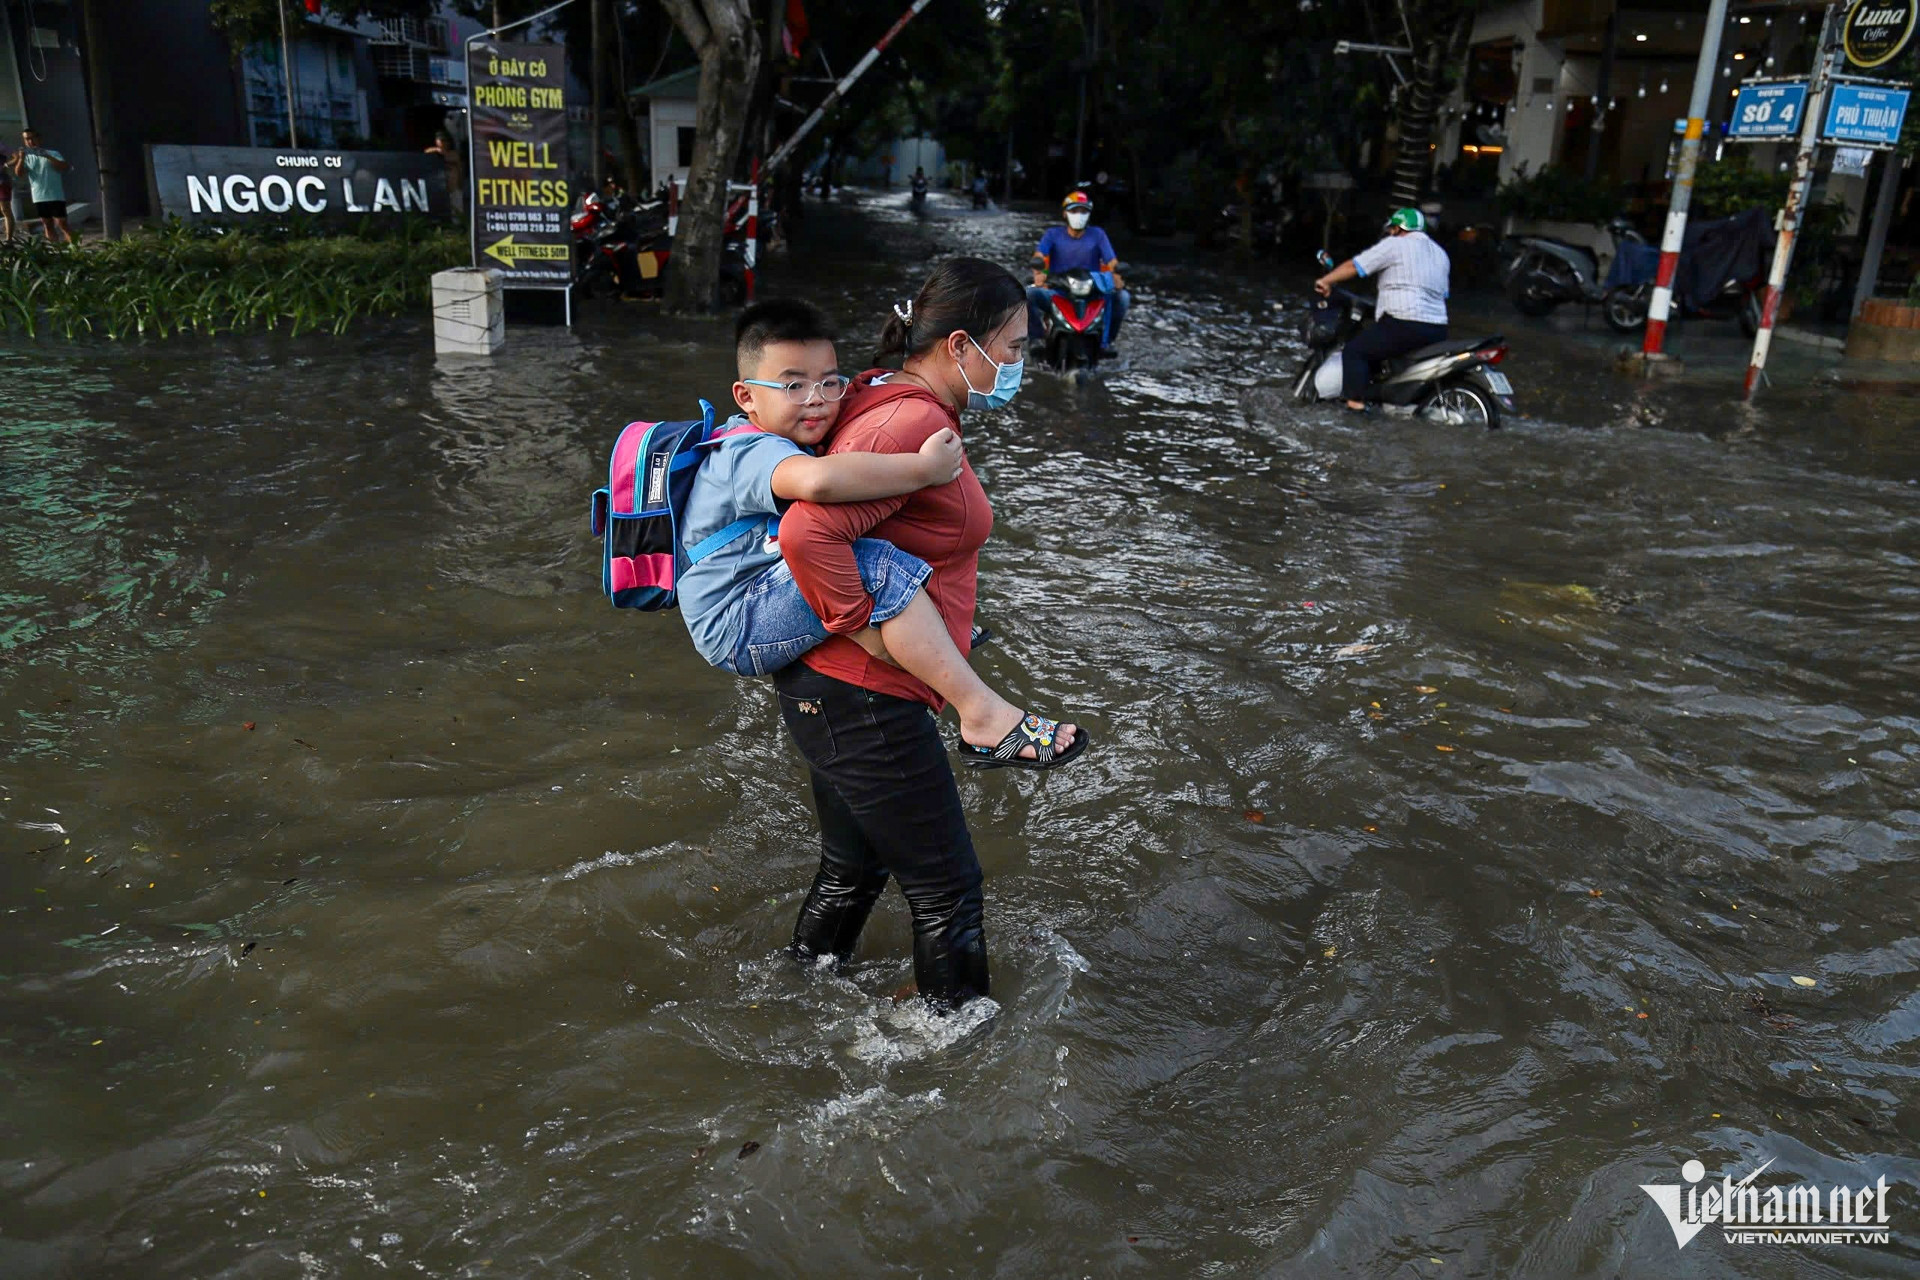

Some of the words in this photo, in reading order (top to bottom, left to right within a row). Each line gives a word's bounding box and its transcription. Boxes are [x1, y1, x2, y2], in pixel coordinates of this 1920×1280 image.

[1854, 6, 1906, 26] Luna
[1863, 27, 1889, 41] Coffee
[501, 58, 526, 77] ĐÂY
[529, 59, 547, 78] CÓ
[475, 82, 527, 108] PHÒNG
[530, 86, 563, 109] GYM
[1742, 97, 1776, 123] SỐ
[1779, 103, 1795, 122] 4
[1835, 103, 1860, 126] PHÚ
[1862, 105, 1899, 131] THUẬN
[276, 155, 319, 168] CHUNG
[323, 156, 342, 168] CƯ
[488, 141, 558, 168] WELL
[342, 178, 430, 212] LAN
[478, 179, 569, 208] FITNESS
[496, 246, 516, 257] WELL
[519, 246, 549, 258] FITNESS
